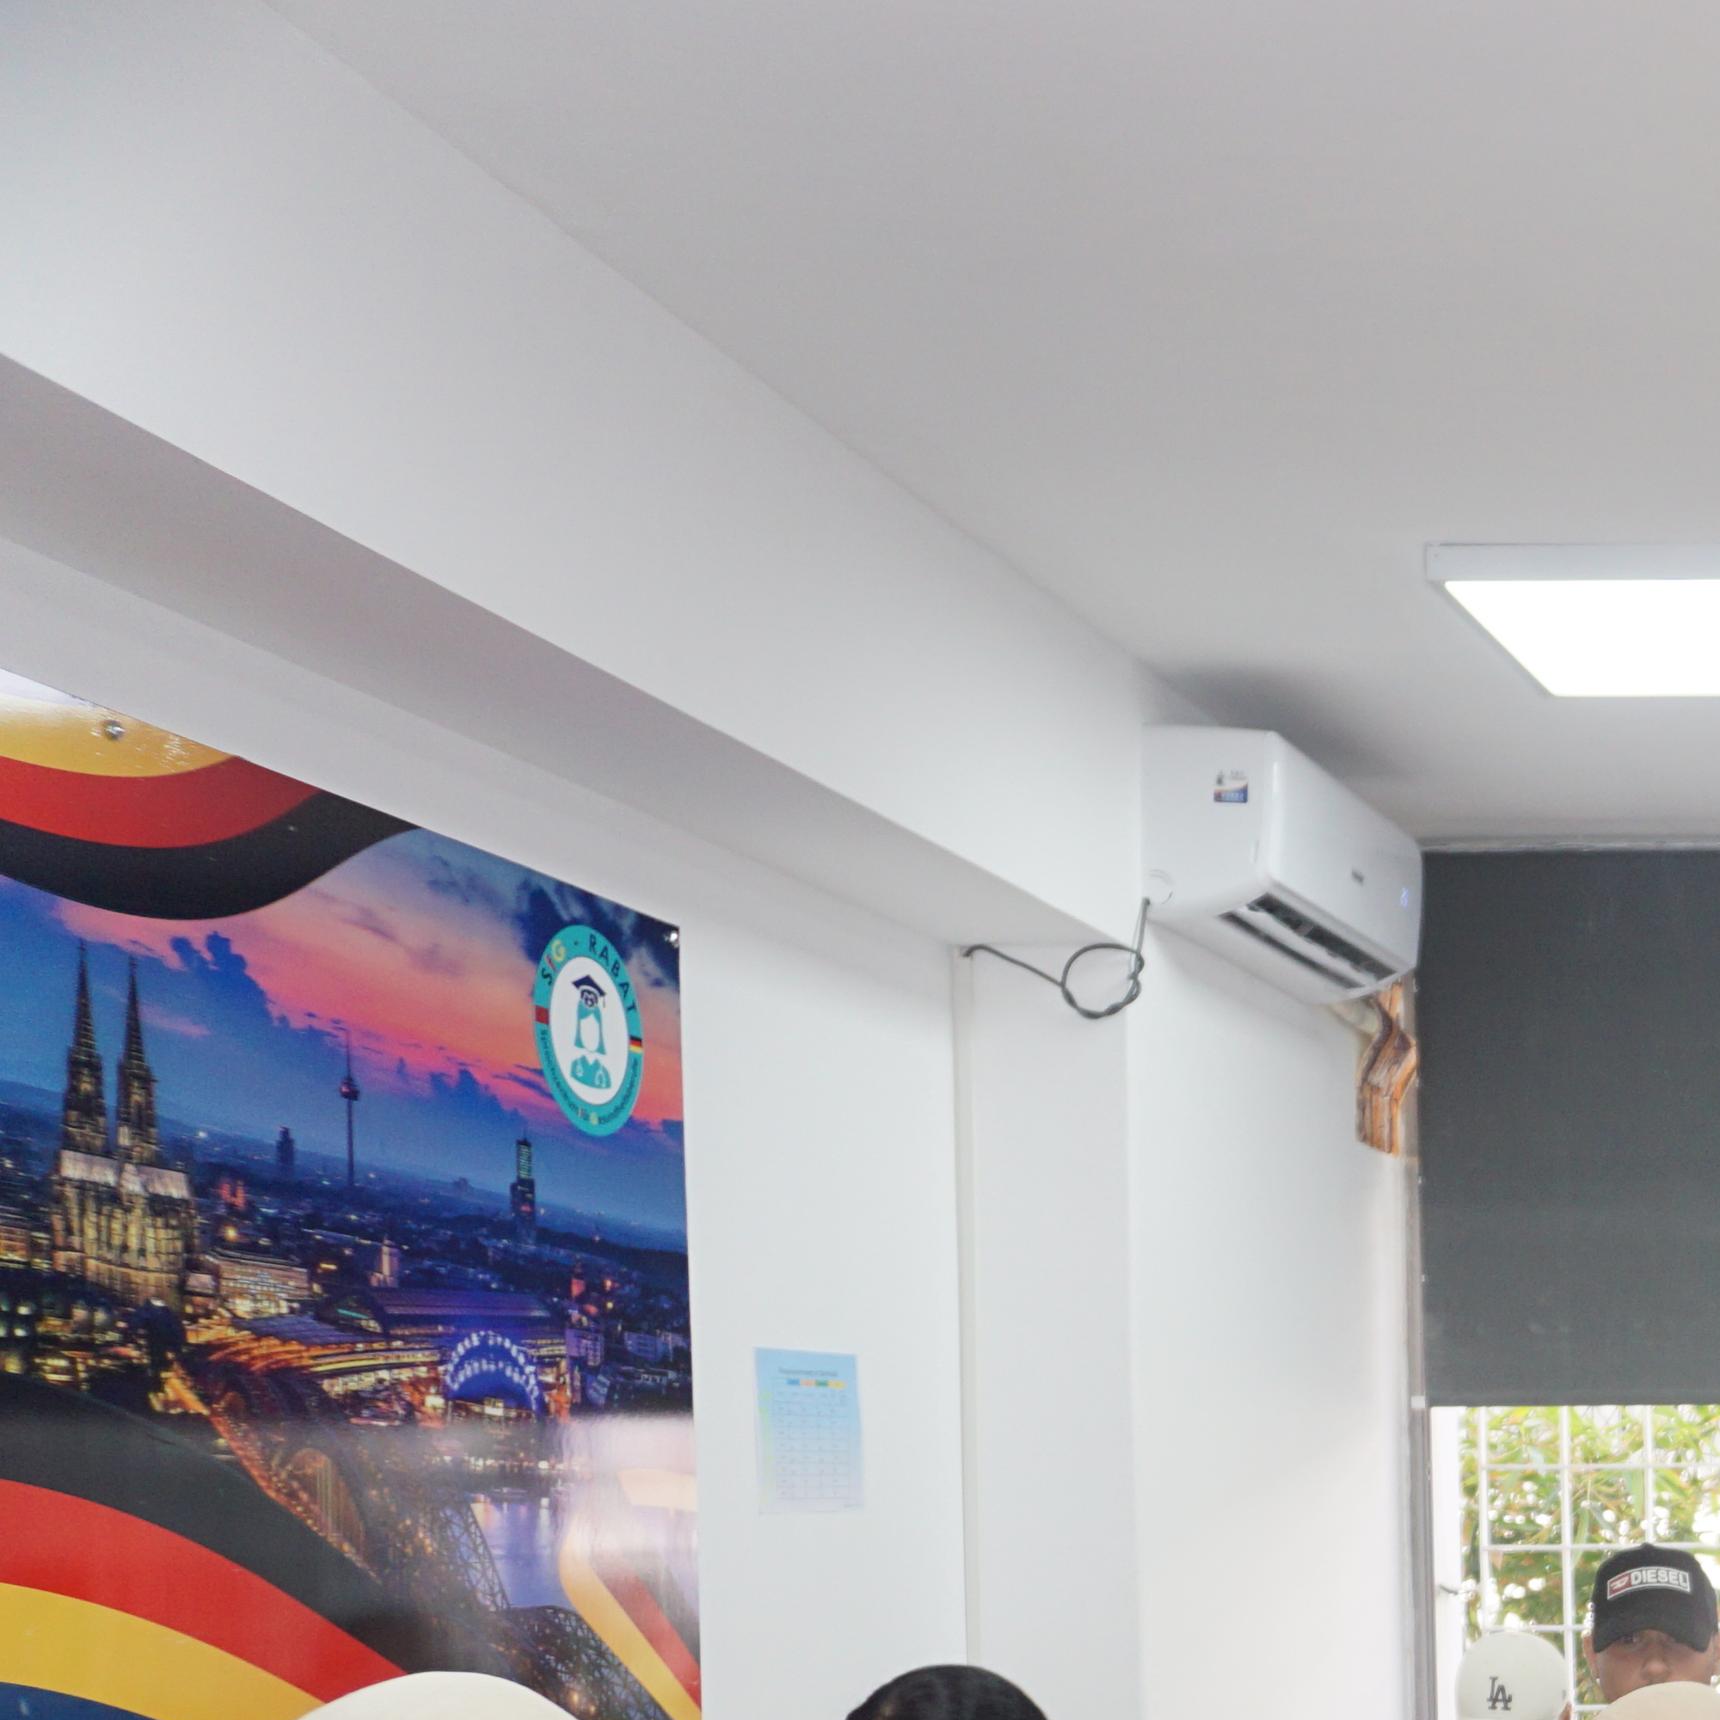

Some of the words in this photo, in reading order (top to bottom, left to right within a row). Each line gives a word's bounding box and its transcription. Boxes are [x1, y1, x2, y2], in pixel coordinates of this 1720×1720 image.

[588, 933, 638, 1013] RABAT
[1630, 1568, 1688, 1587] DIESEL
[1486, 1676, 1512, 1711] LA
